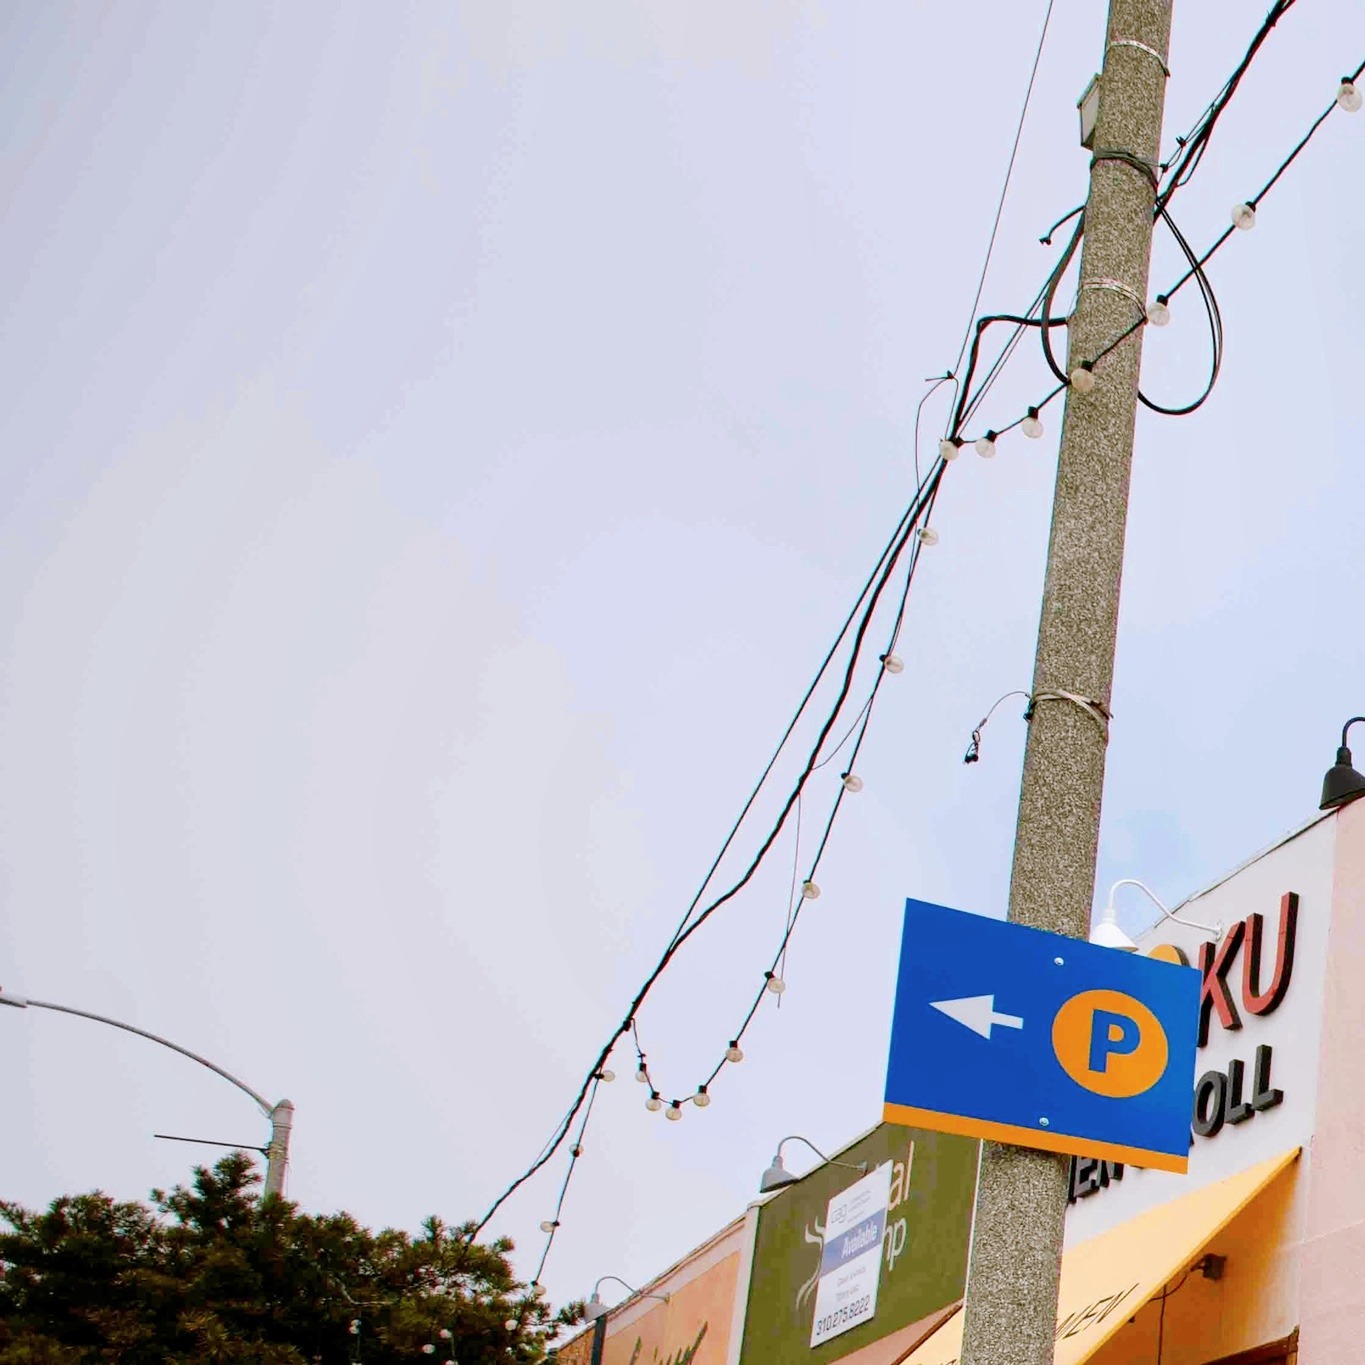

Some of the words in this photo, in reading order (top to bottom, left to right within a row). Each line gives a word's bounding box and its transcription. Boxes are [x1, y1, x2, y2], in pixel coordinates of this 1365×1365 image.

[1190, 891, 1300, 1048] KU
[1088, 1008, 1142, 1074] P
[1189, 1043, 1285, 1146] OLL
